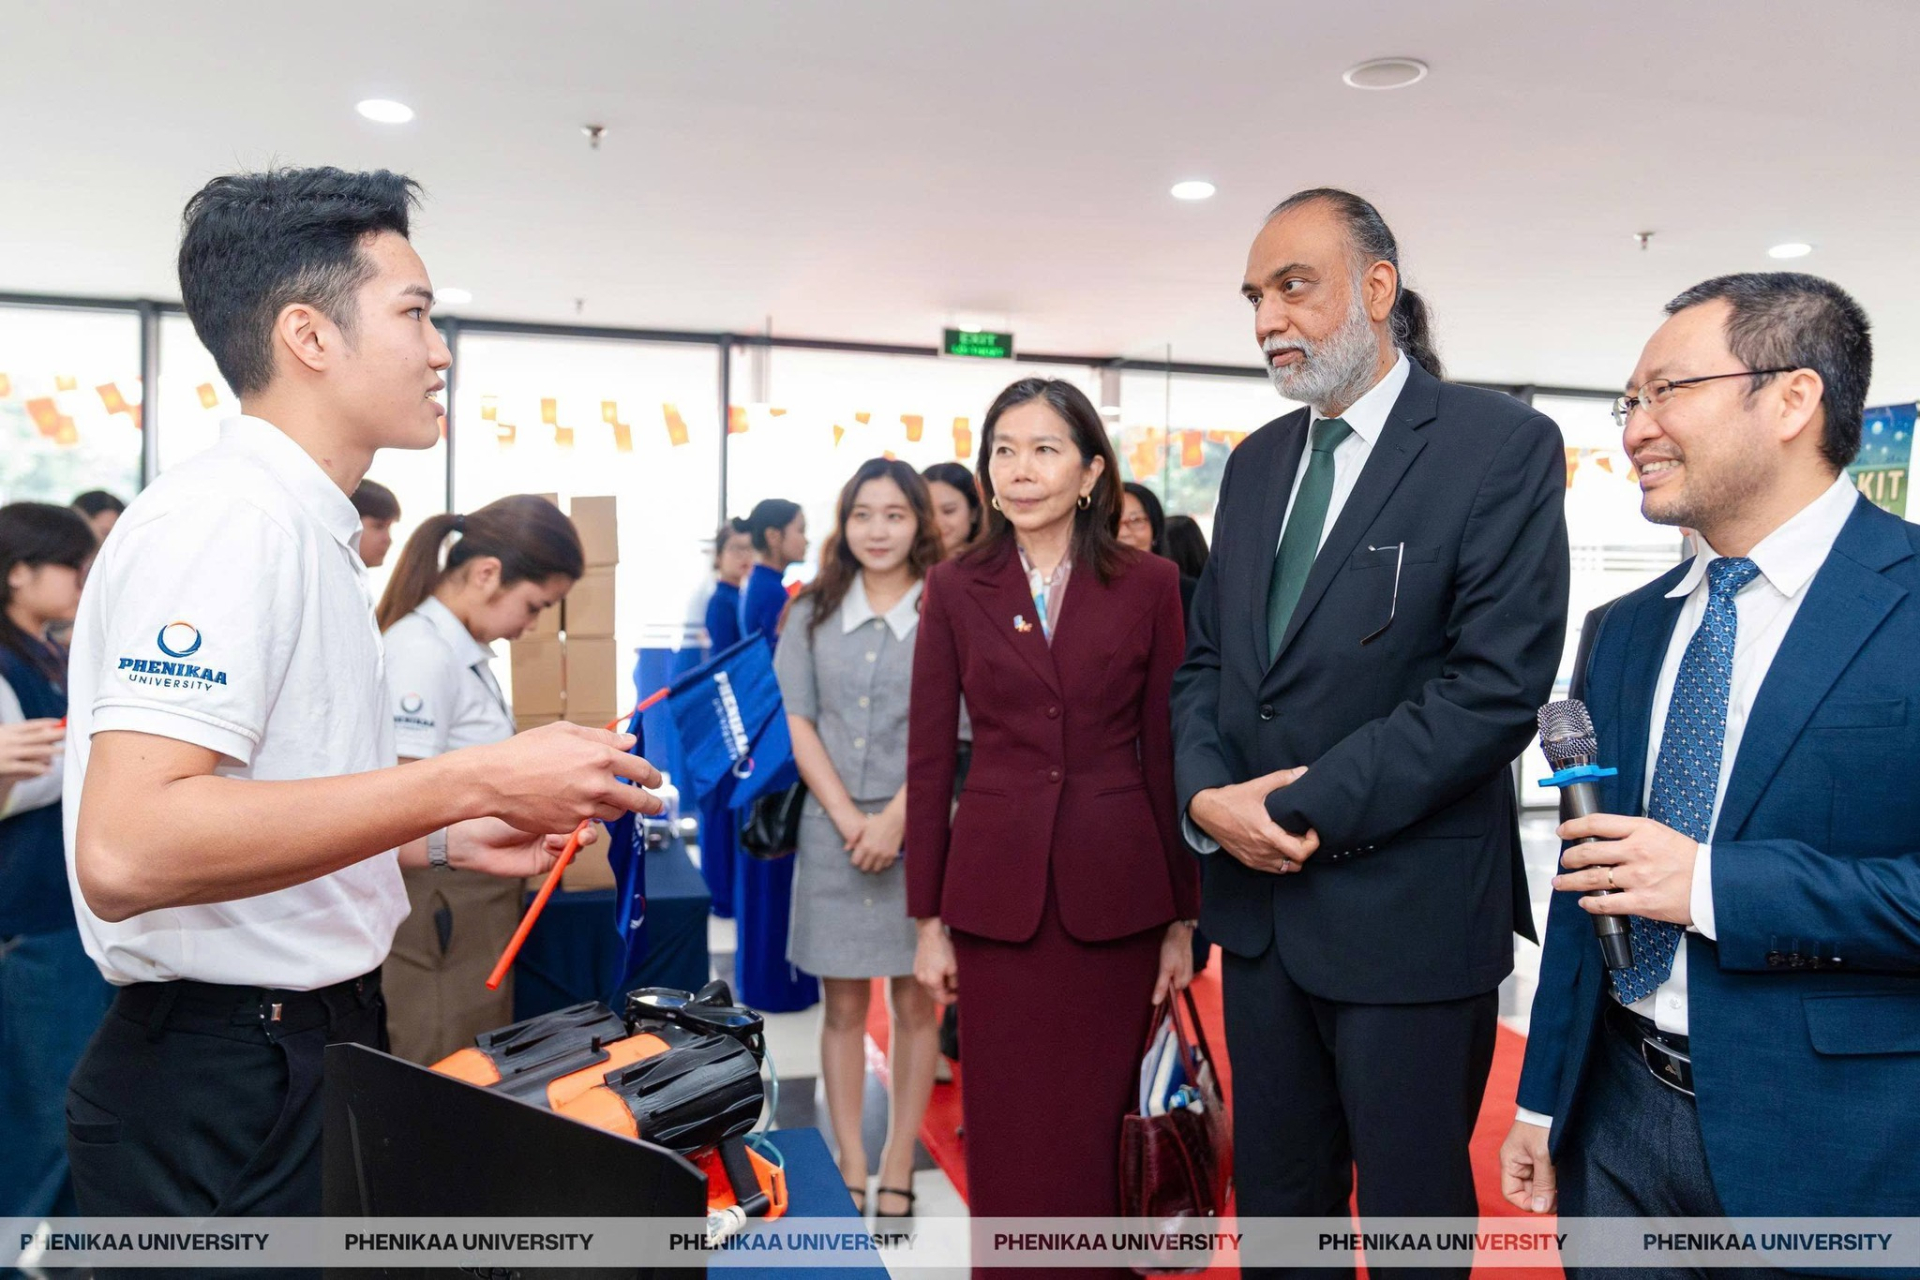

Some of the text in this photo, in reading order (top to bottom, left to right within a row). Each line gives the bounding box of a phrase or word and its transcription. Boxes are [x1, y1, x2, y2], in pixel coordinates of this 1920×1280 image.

[1857, 469, 1905, 501] KIT
[118, 657, 227, 686] PHENIKAA
[129, 674, 212, 691] UNIVERSITY
